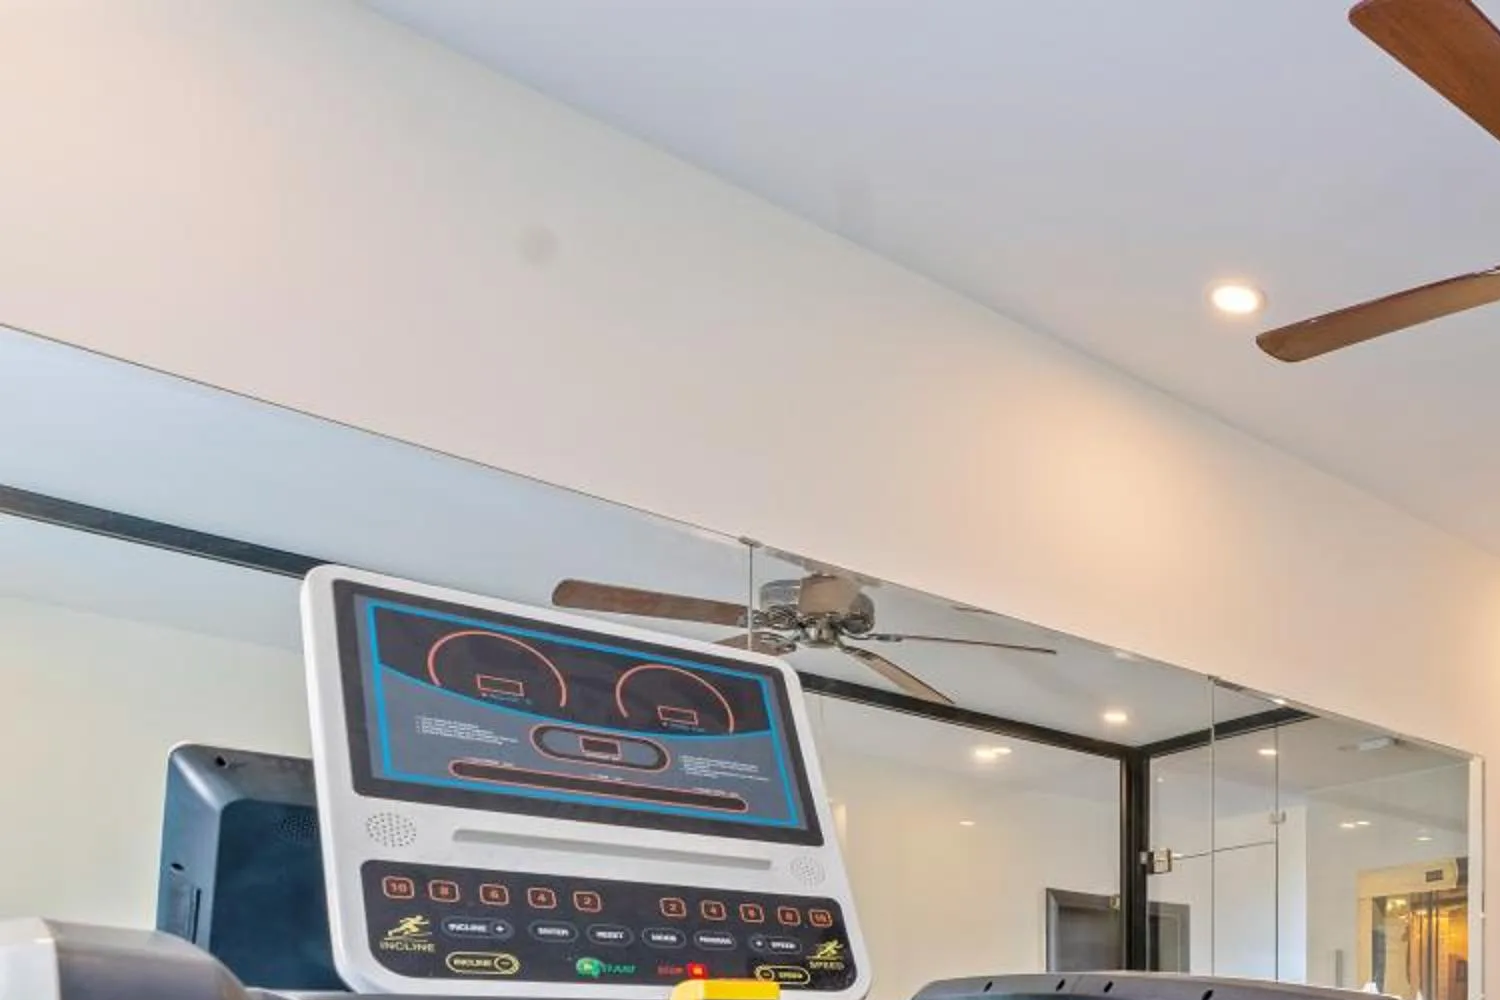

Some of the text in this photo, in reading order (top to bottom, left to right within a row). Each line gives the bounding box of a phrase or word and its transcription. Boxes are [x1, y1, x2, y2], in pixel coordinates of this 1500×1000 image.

[390, 882, 408, 894] 10
[536, 892, 547, 903] 4
[379, 941, 437, 953] INCLINE
[809, 960, 846, 972] SPEED
